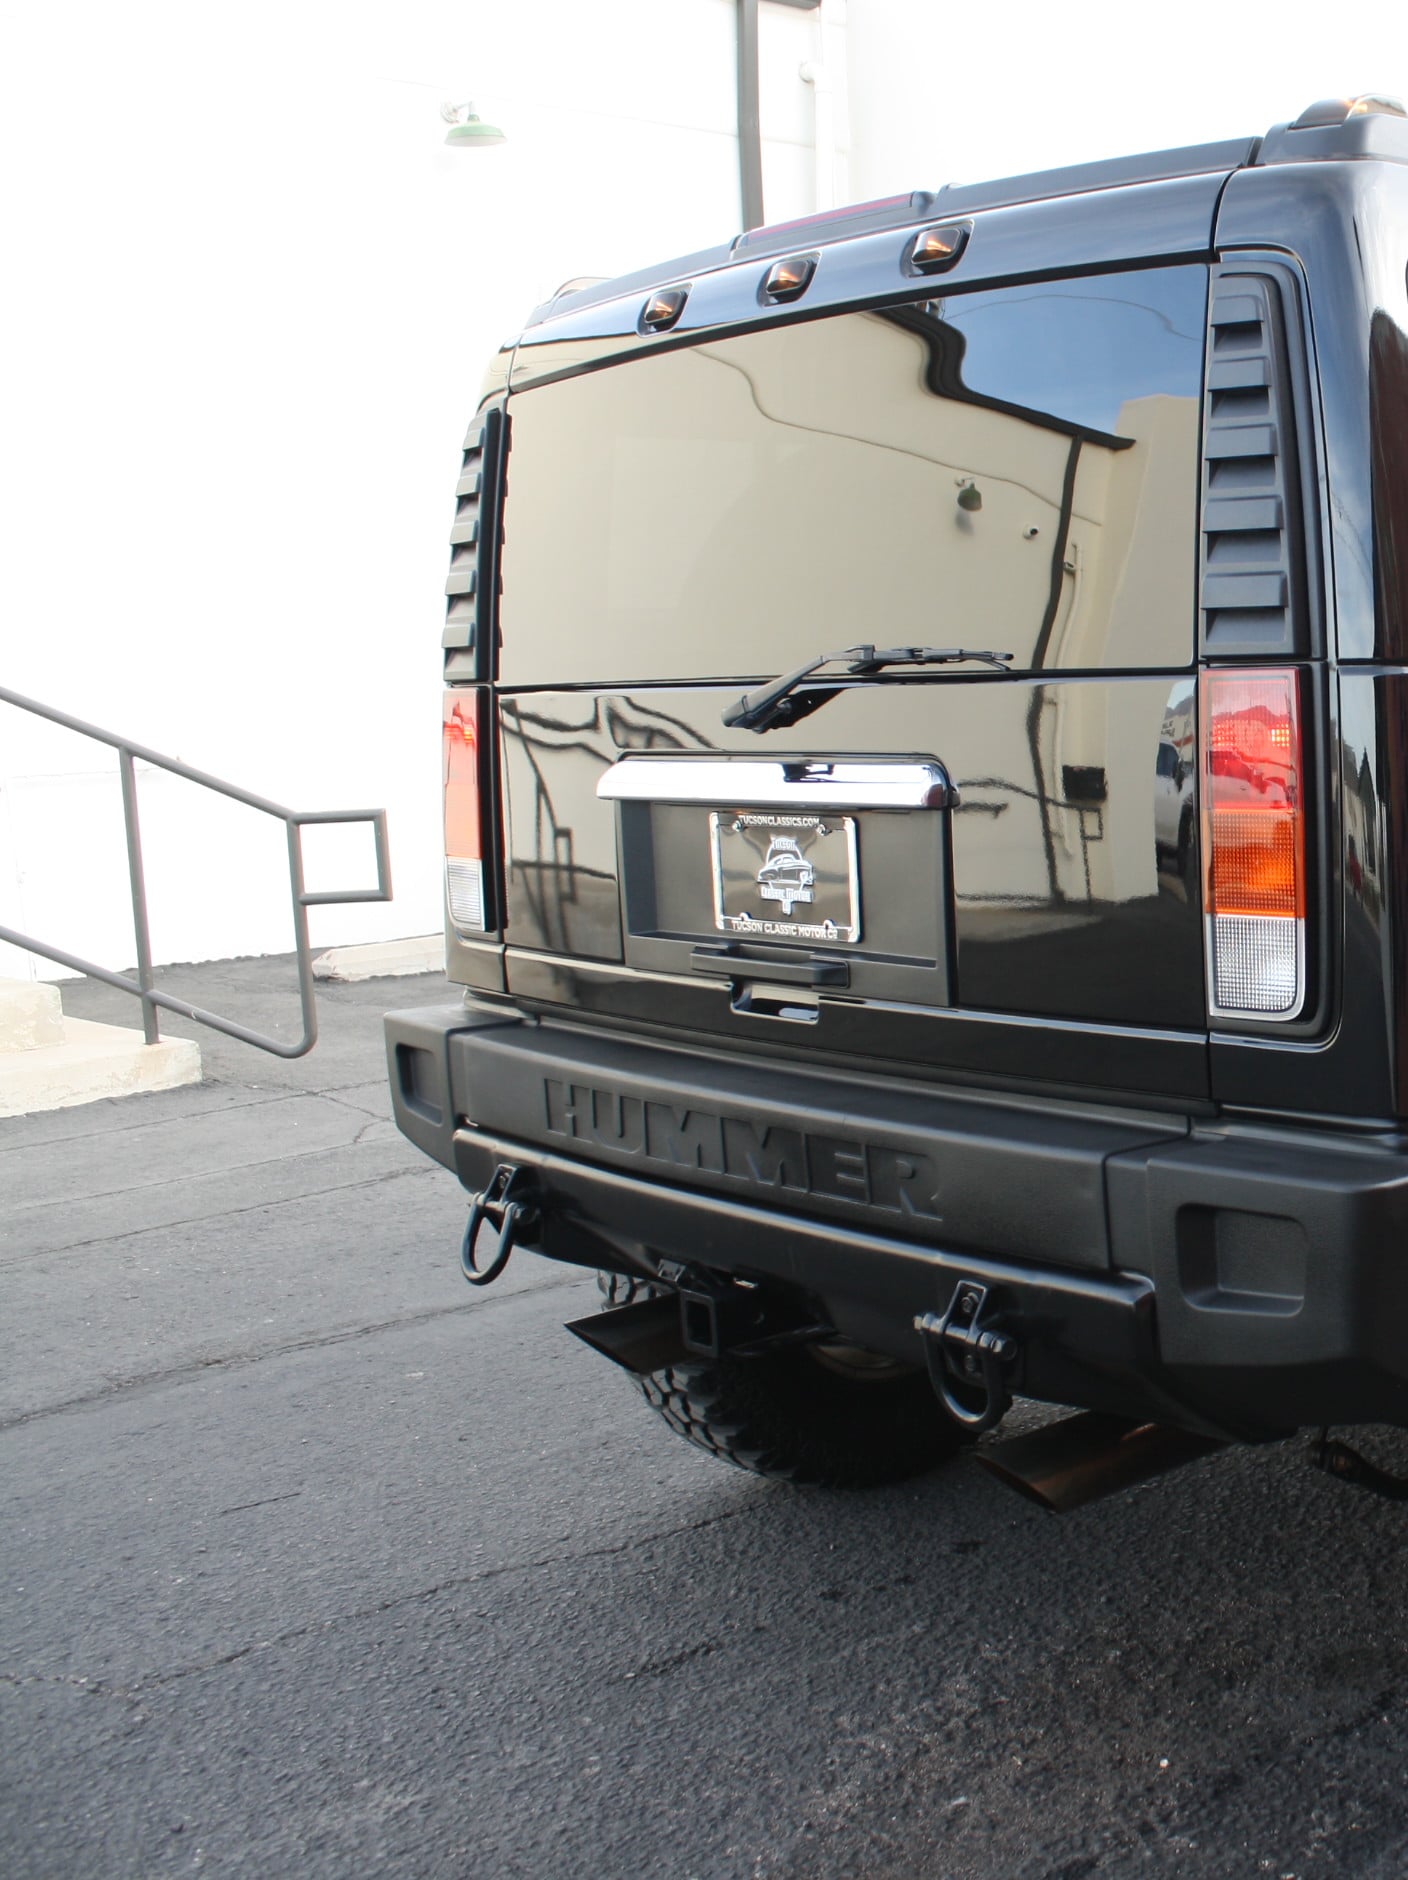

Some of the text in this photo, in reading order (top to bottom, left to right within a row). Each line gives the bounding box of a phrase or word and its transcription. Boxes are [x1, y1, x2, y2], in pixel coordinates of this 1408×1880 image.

[738, 814, 820, 827] TUCSONCLASSICS.COM
[731, 920, 763, 932] TUCSON
[764, 924, 797, 935] CLASSIC
[798, 926, 827, 938] MOTOR
[544, 1077, 944, 1222] HUMMER
